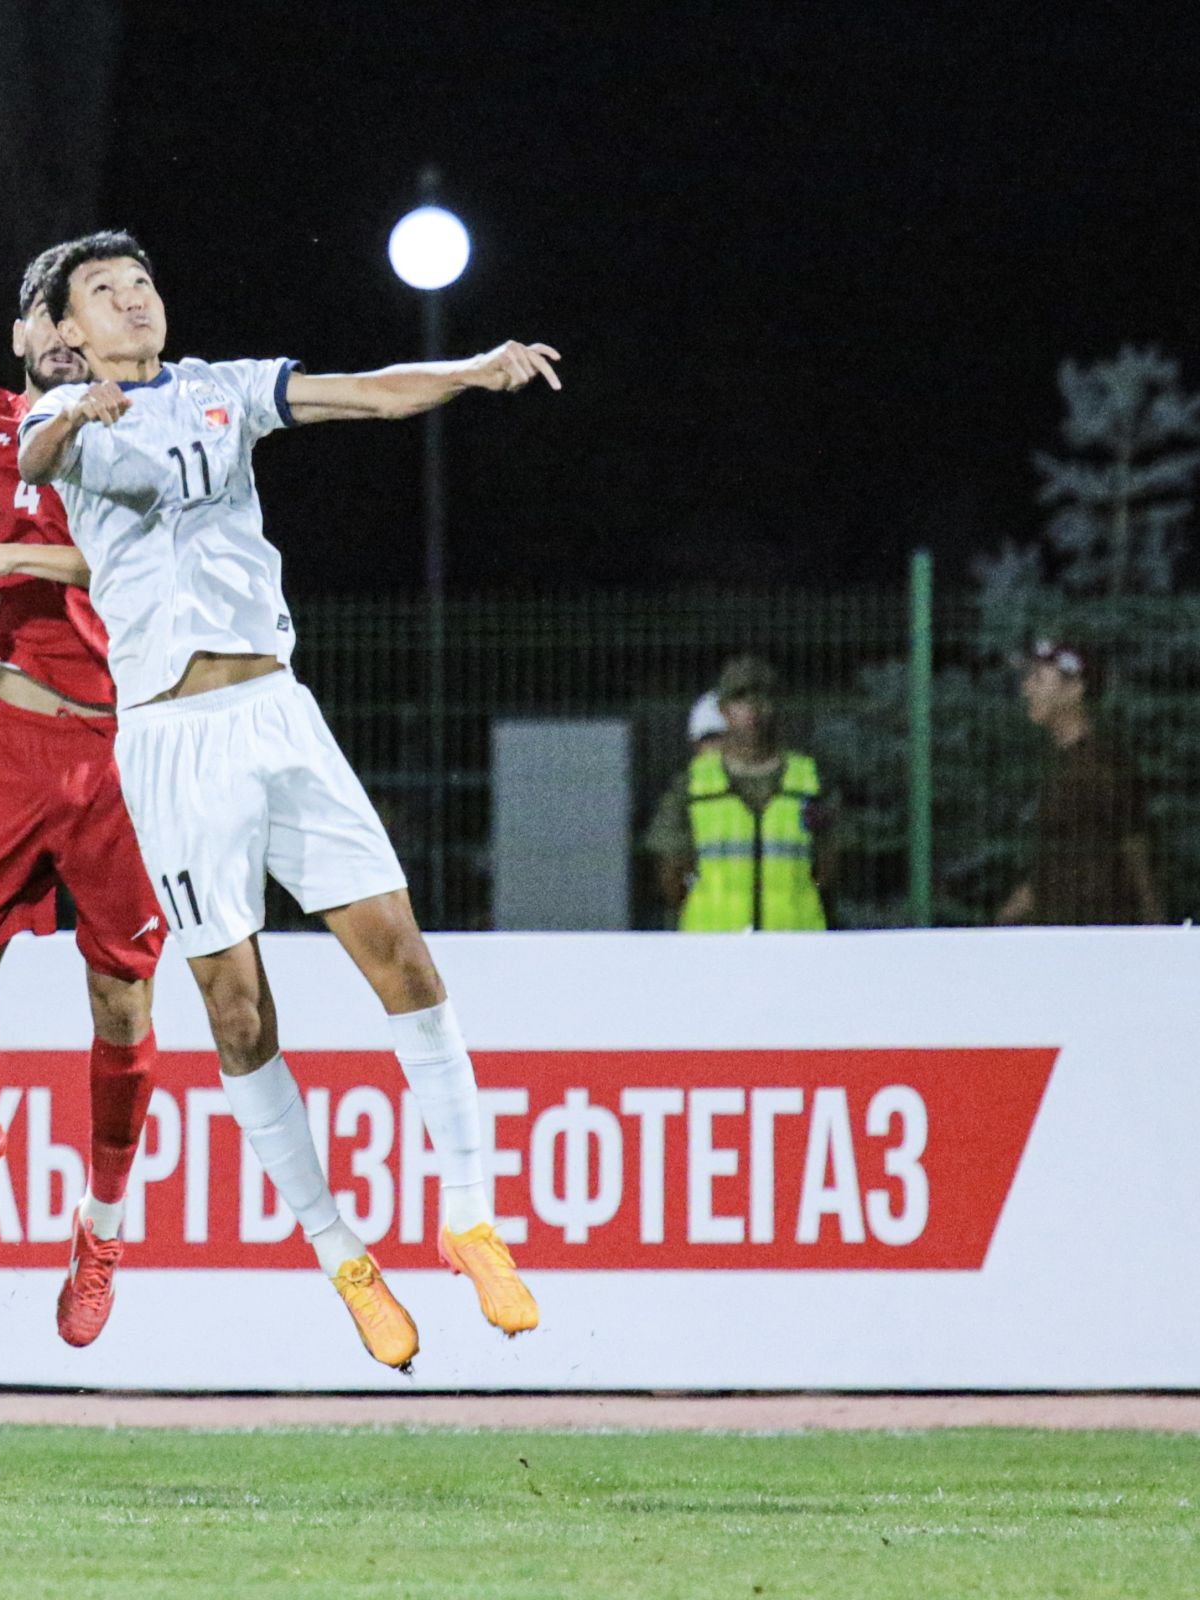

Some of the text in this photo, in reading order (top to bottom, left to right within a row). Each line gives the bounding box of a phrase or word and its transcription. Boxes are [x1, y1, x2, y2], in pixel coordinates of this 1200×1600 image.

[13, 479, 41, 515] 4
[167, 440, 212, 499] 11
[161, 869, 203, 930] 11
